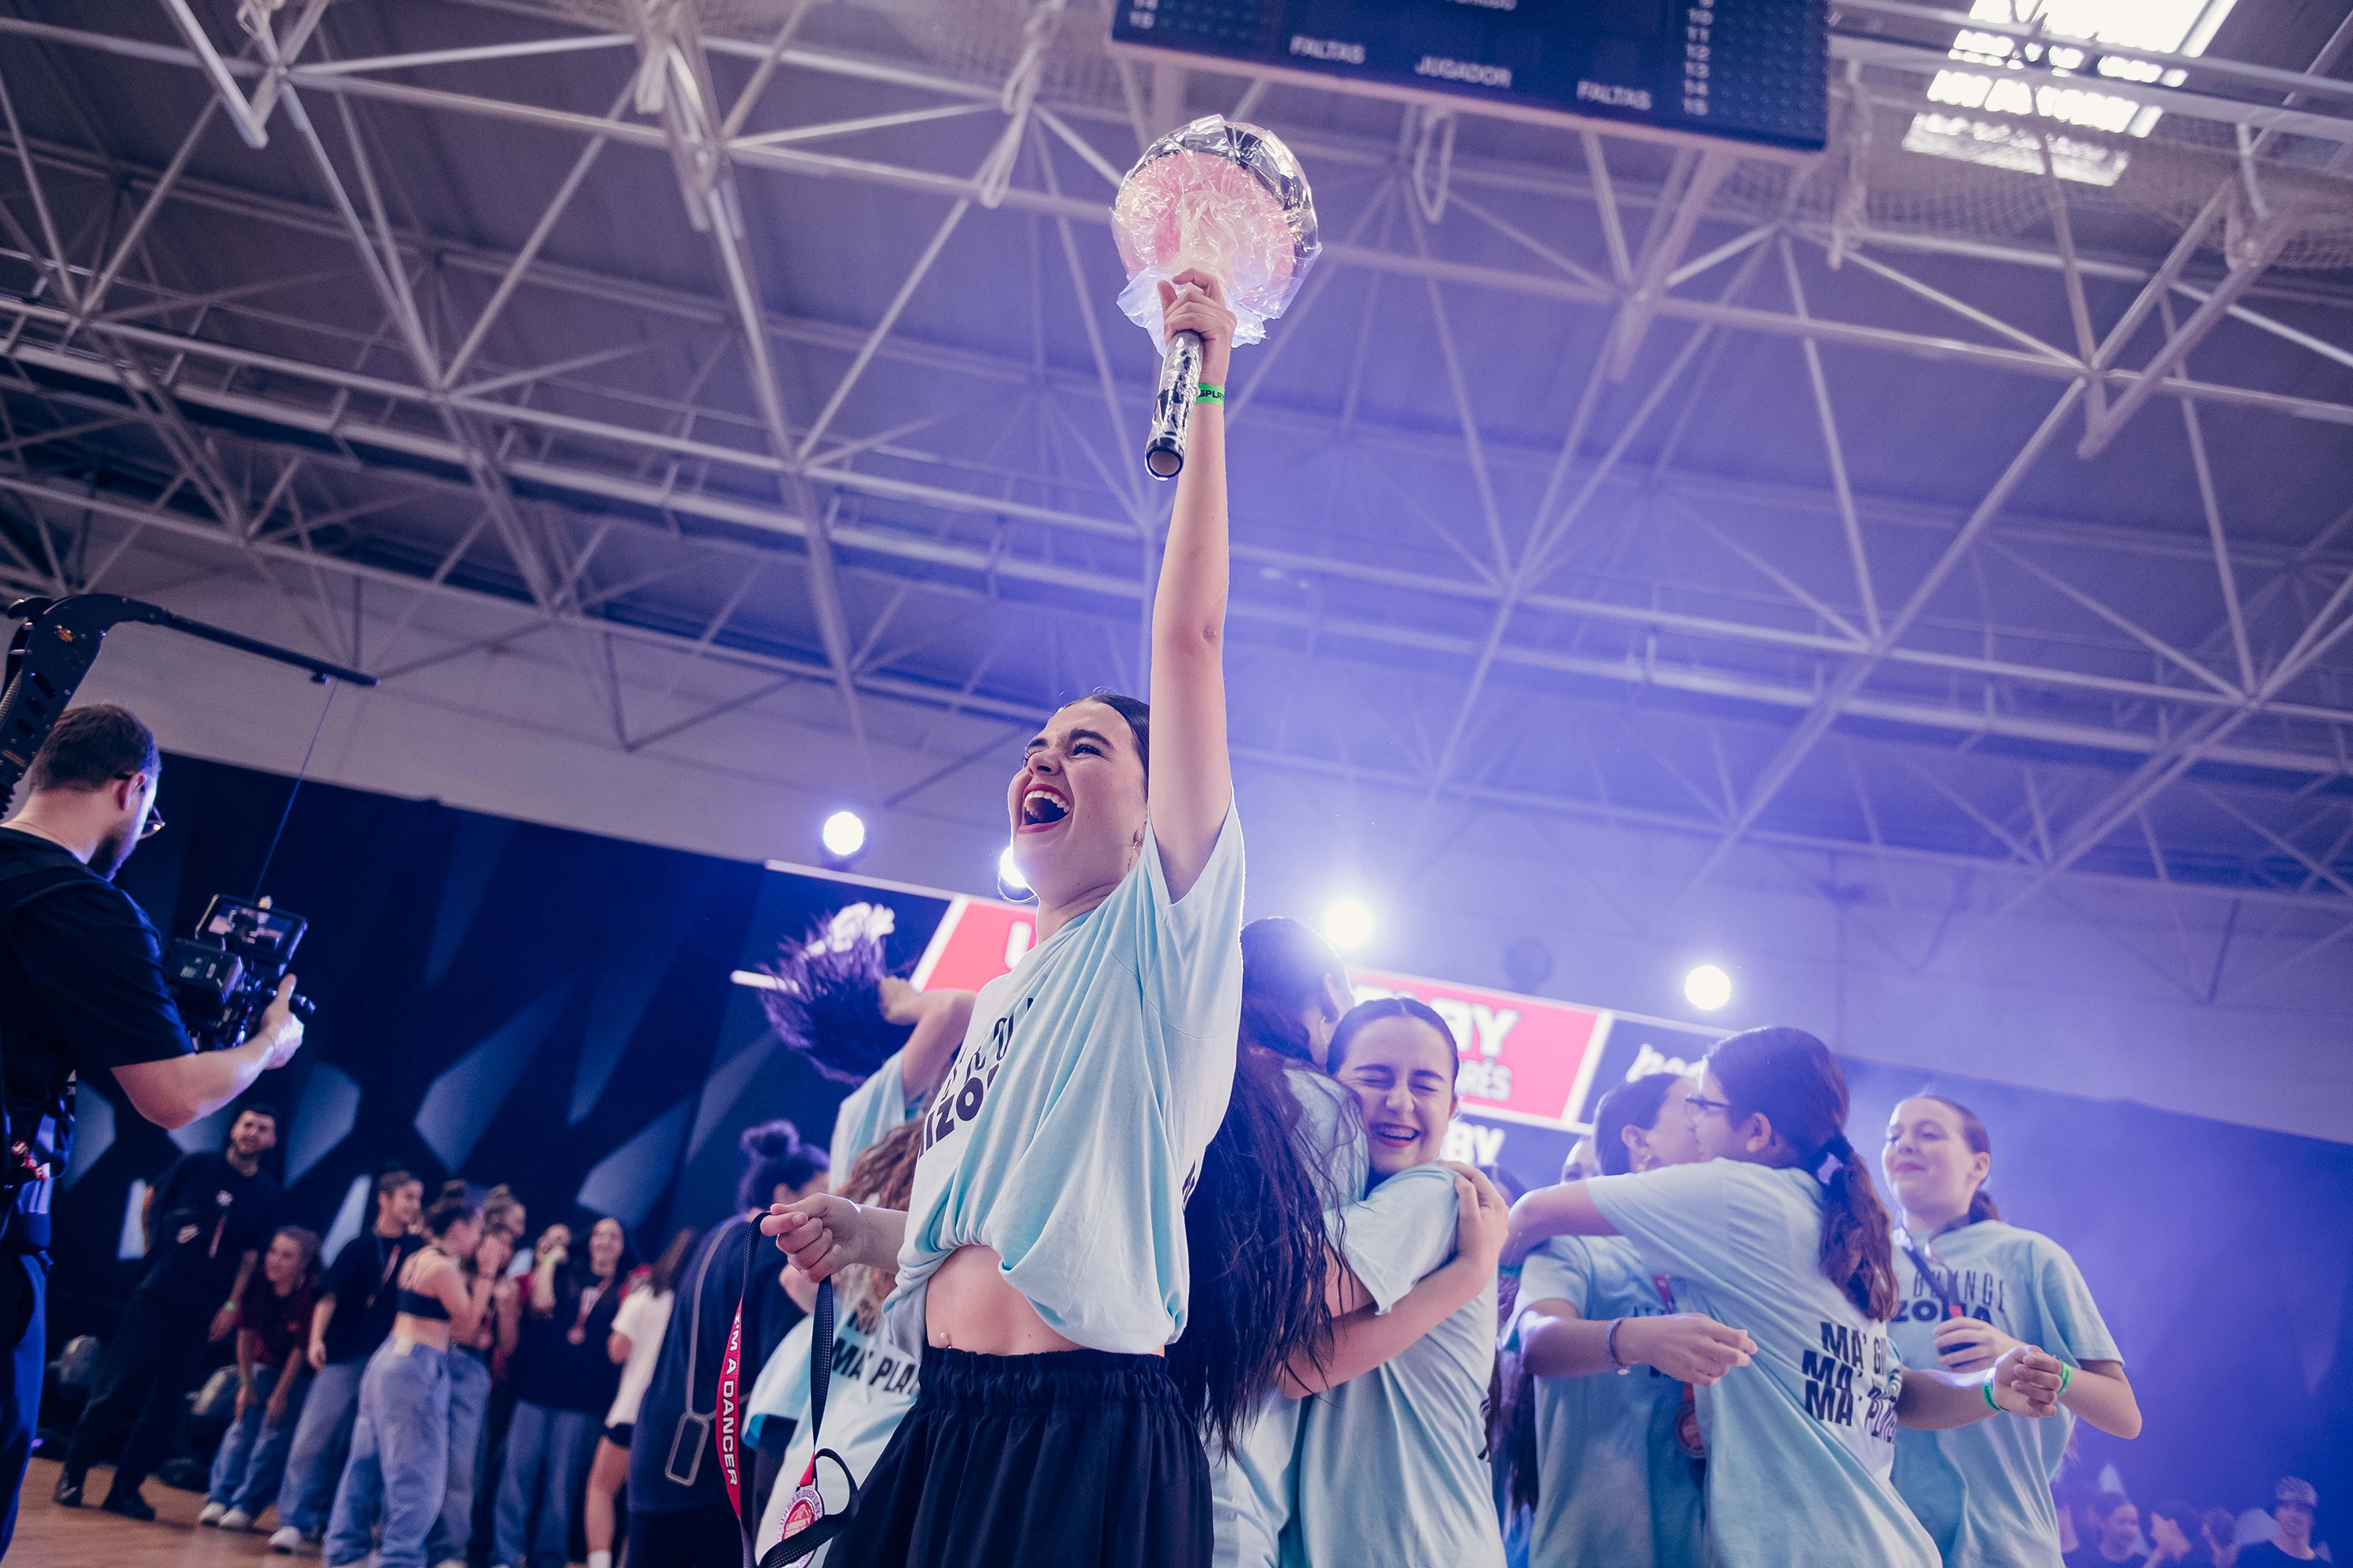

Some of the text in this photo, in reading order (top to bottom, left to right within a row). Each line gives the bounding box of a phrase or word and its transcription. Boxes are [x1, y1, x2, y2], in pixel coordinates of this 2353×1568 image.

[1688, 9, 1713, 25] 10
[1687, 26, 1710, 42] 11
[1290, 35, 1365, 65] FALTAS
[1686, 44, 1711, 61] 12
[1415, 55, 1512, 89] JUGADOR
[1685, 62, 1709, 78] 13
[1577, 81, 1652, 111] FALTAS
[1683, 79, 1709, 97] 14
[1683, 97, 1709, 116] 15
[723, 1312, 740, 1486] I'M A DANCER
